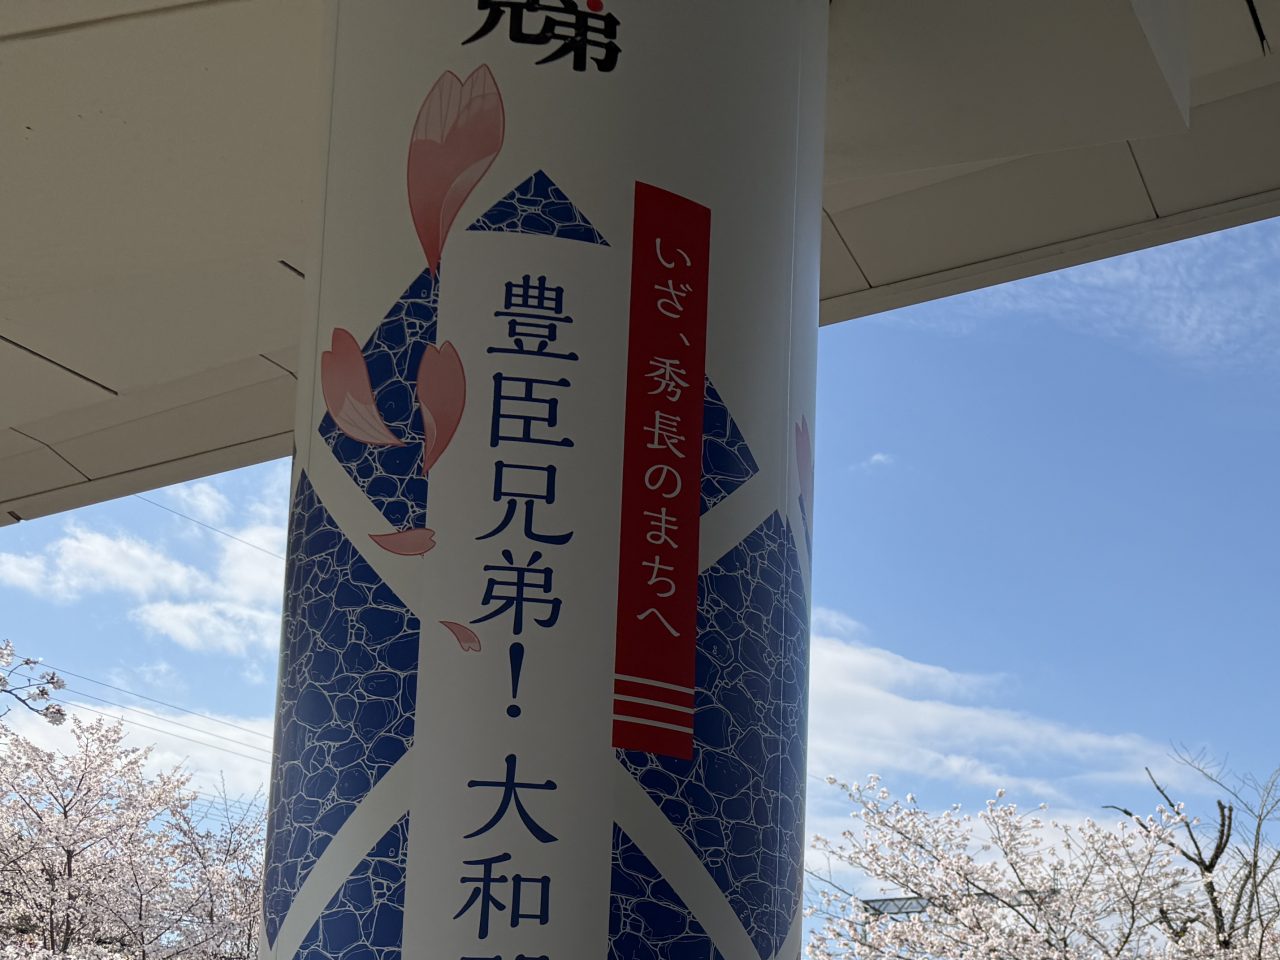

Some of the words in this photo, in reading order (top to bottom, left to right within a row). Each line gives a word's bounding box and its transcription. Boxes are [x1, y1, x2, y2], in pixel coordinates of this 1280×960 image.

[636, 237, 693, 638] いざ、秀長のまちへ
